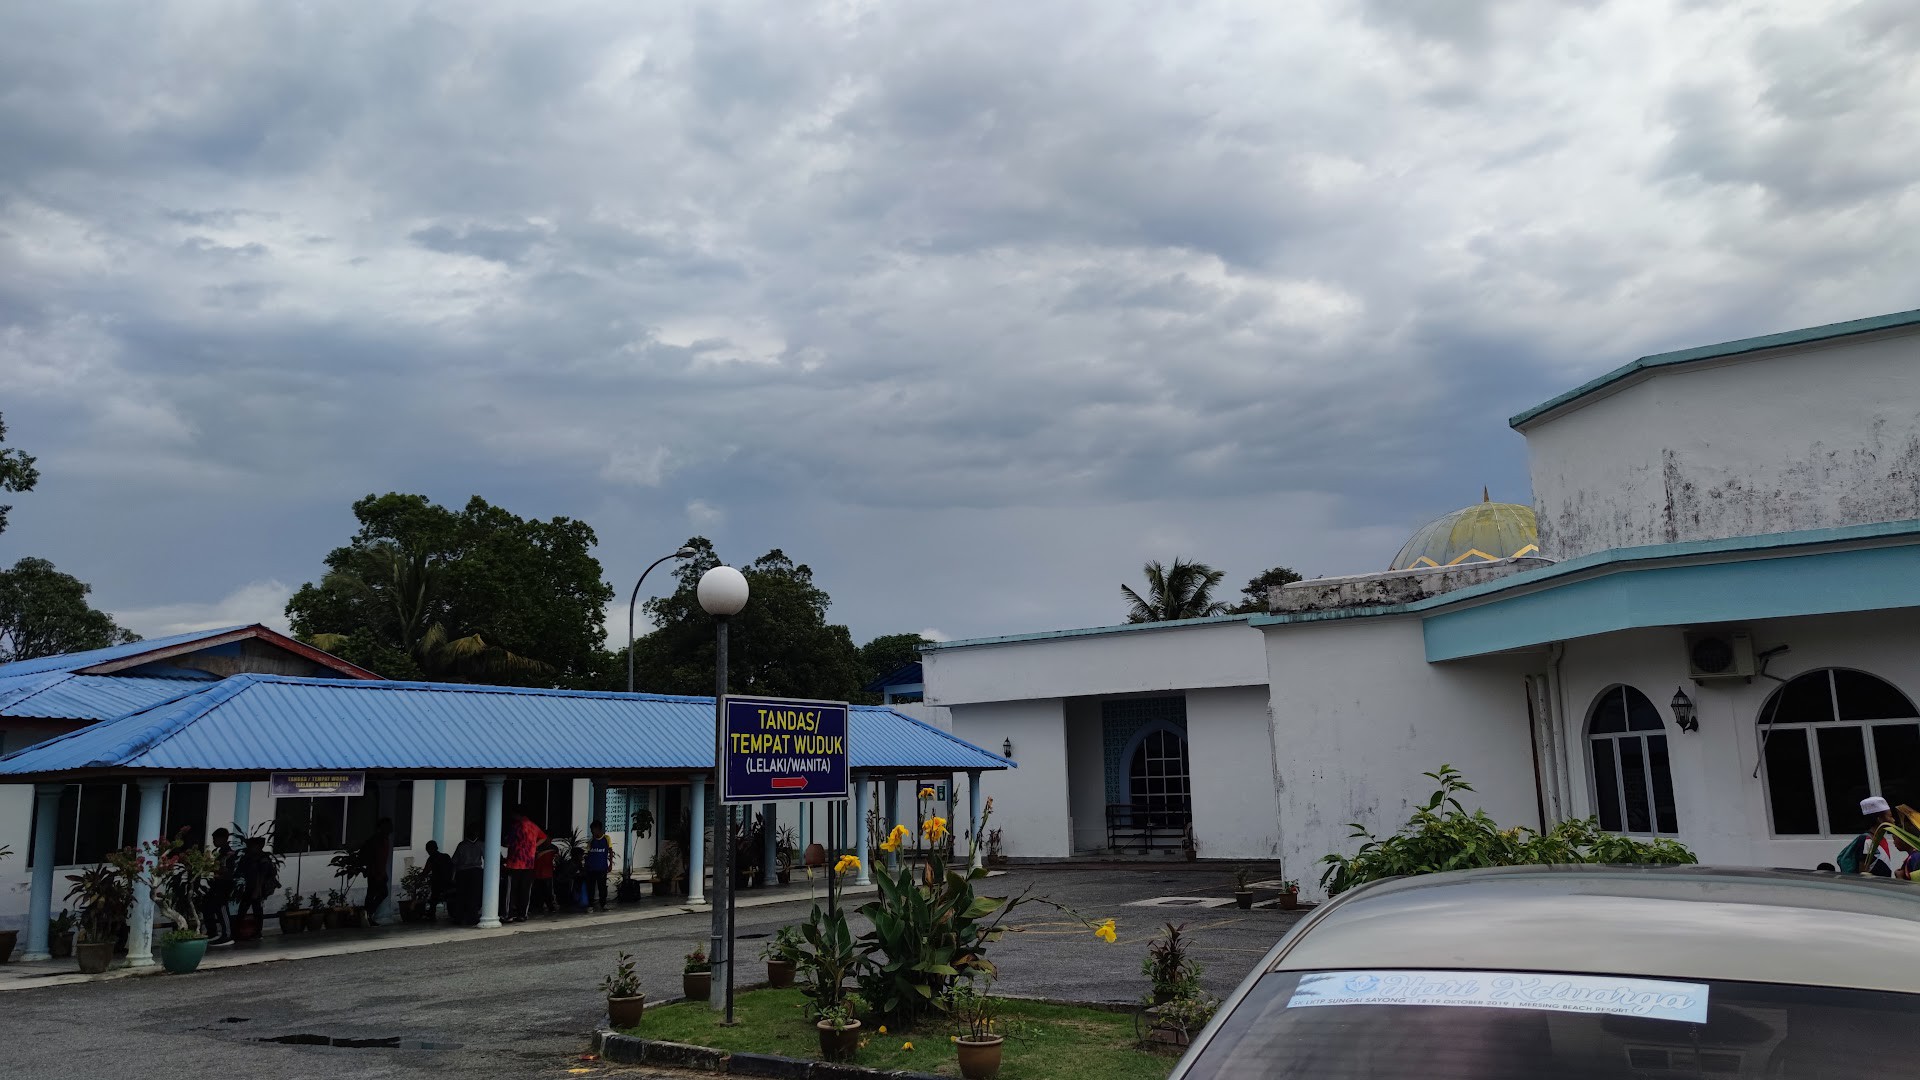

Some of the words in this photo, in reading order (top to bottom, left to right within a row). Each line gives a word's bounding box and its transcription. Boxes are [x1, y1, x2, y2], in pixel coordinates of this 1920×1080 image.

[757, 709, 822, 734] TANDAS/
[730, 733, 790, 754] TEMPAT
[793, 735, 843, 754] WUDUK
[746, 757, 831, 775] (LELAKI/WANITA)
[1490, 976, 1696, 1014] Keluarga
